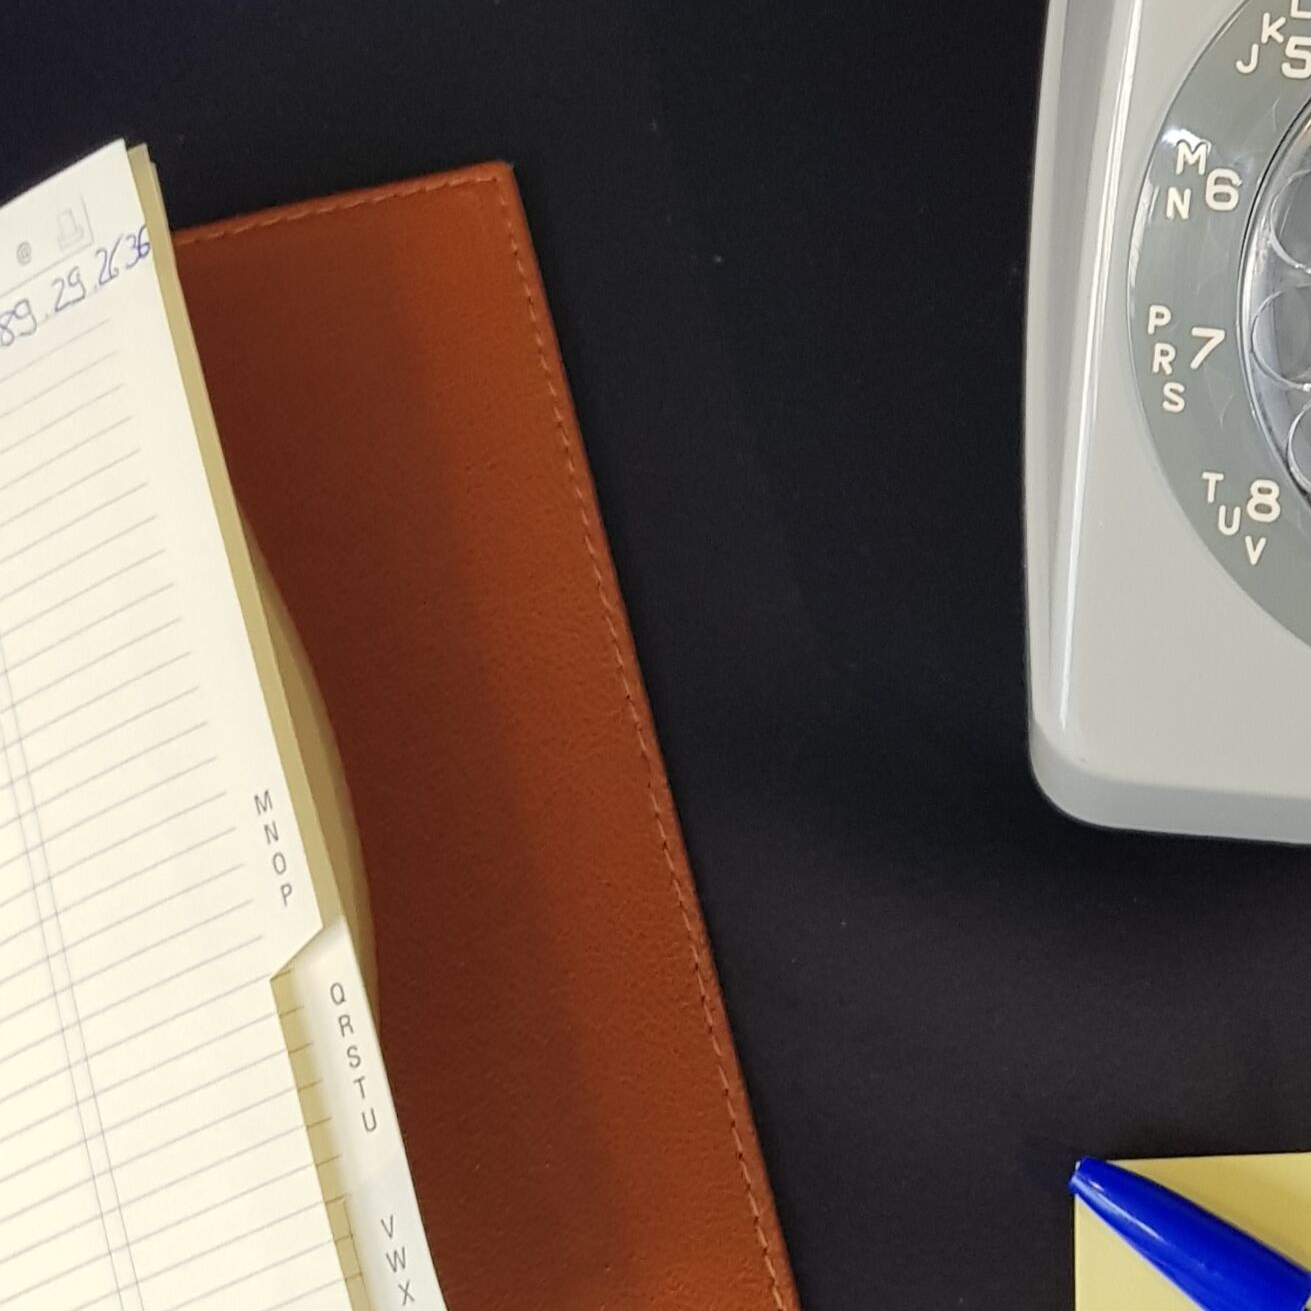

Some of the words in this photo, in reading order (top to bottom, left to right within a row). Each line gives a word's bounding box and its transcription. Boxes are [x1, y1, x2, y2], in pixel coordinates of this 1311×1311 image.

[1205, 168, 1242, 211] 6
[1190, 326, 1226, 370] 7
[1201, 471, 1266, 567] TUV
[1246, 479, 1281, 524] 8
